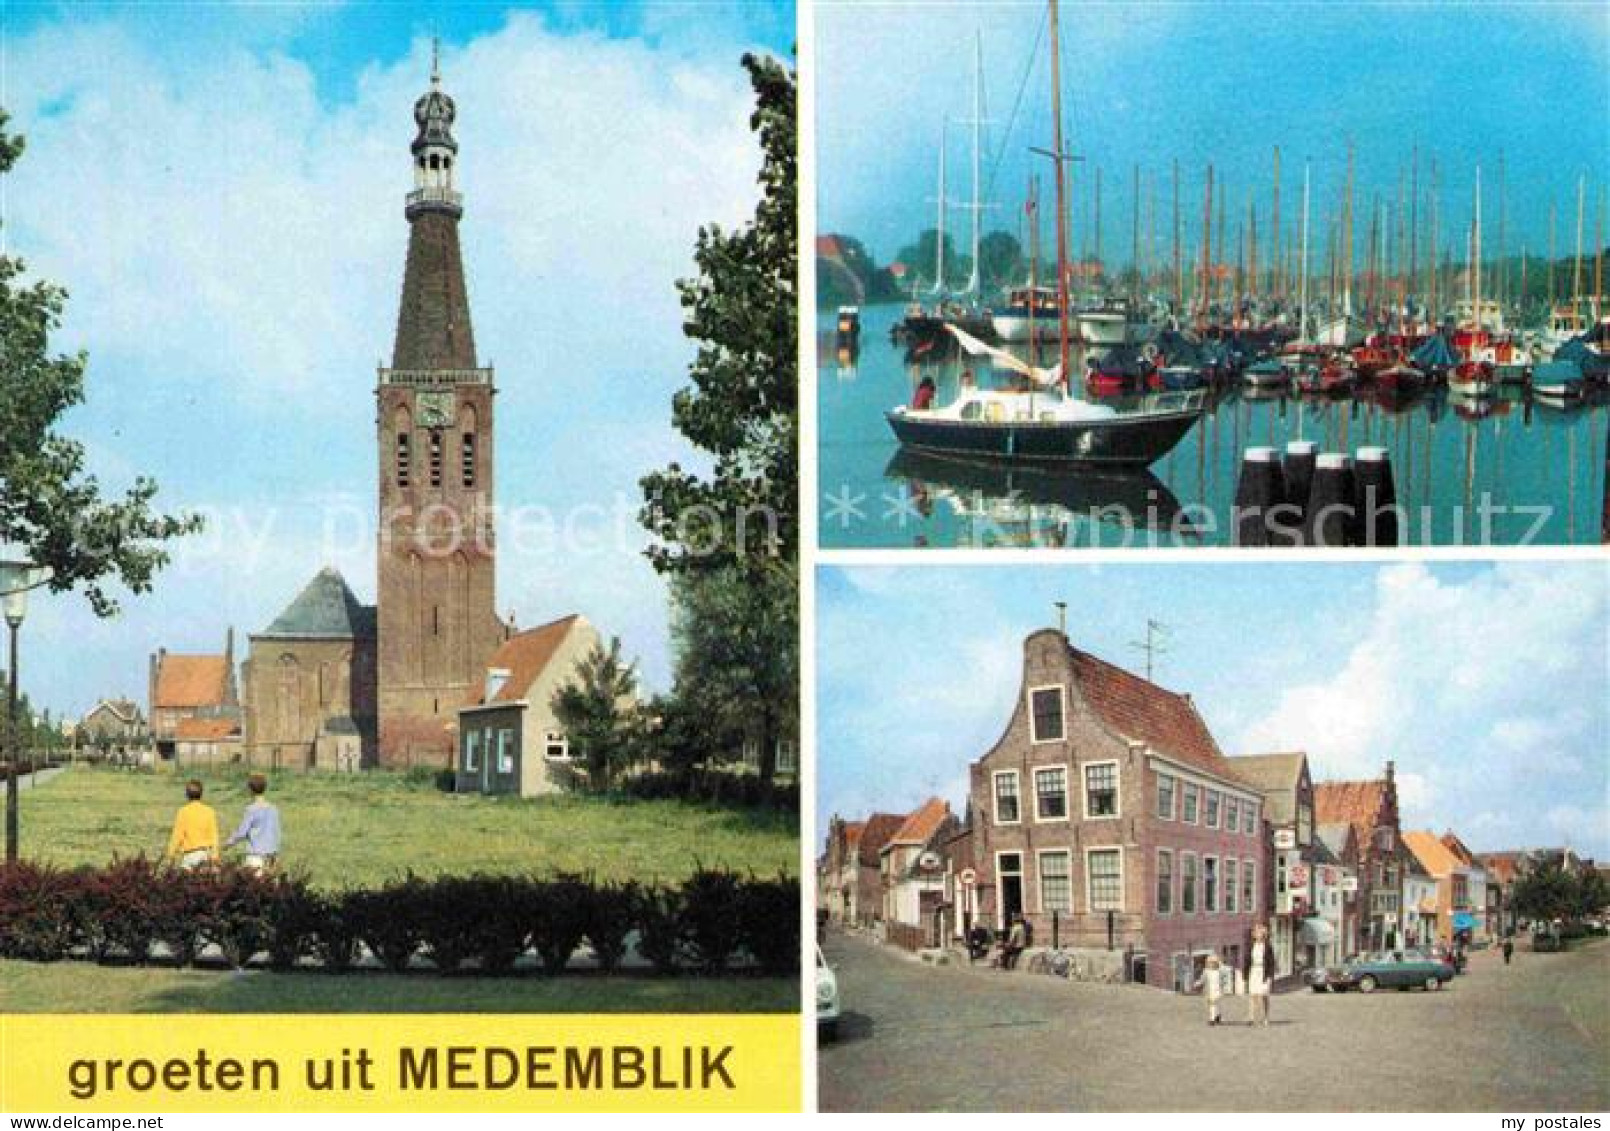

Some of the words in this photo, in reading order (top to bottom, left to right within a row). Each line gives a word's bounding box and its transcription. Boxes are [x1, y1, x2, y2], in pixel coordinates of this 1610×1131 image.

[69, 1048, 279, 1100] groeten
[305, 1048, 375, 1091] uit
[399, 1045, 737, 1091] MEDEMBLIK
